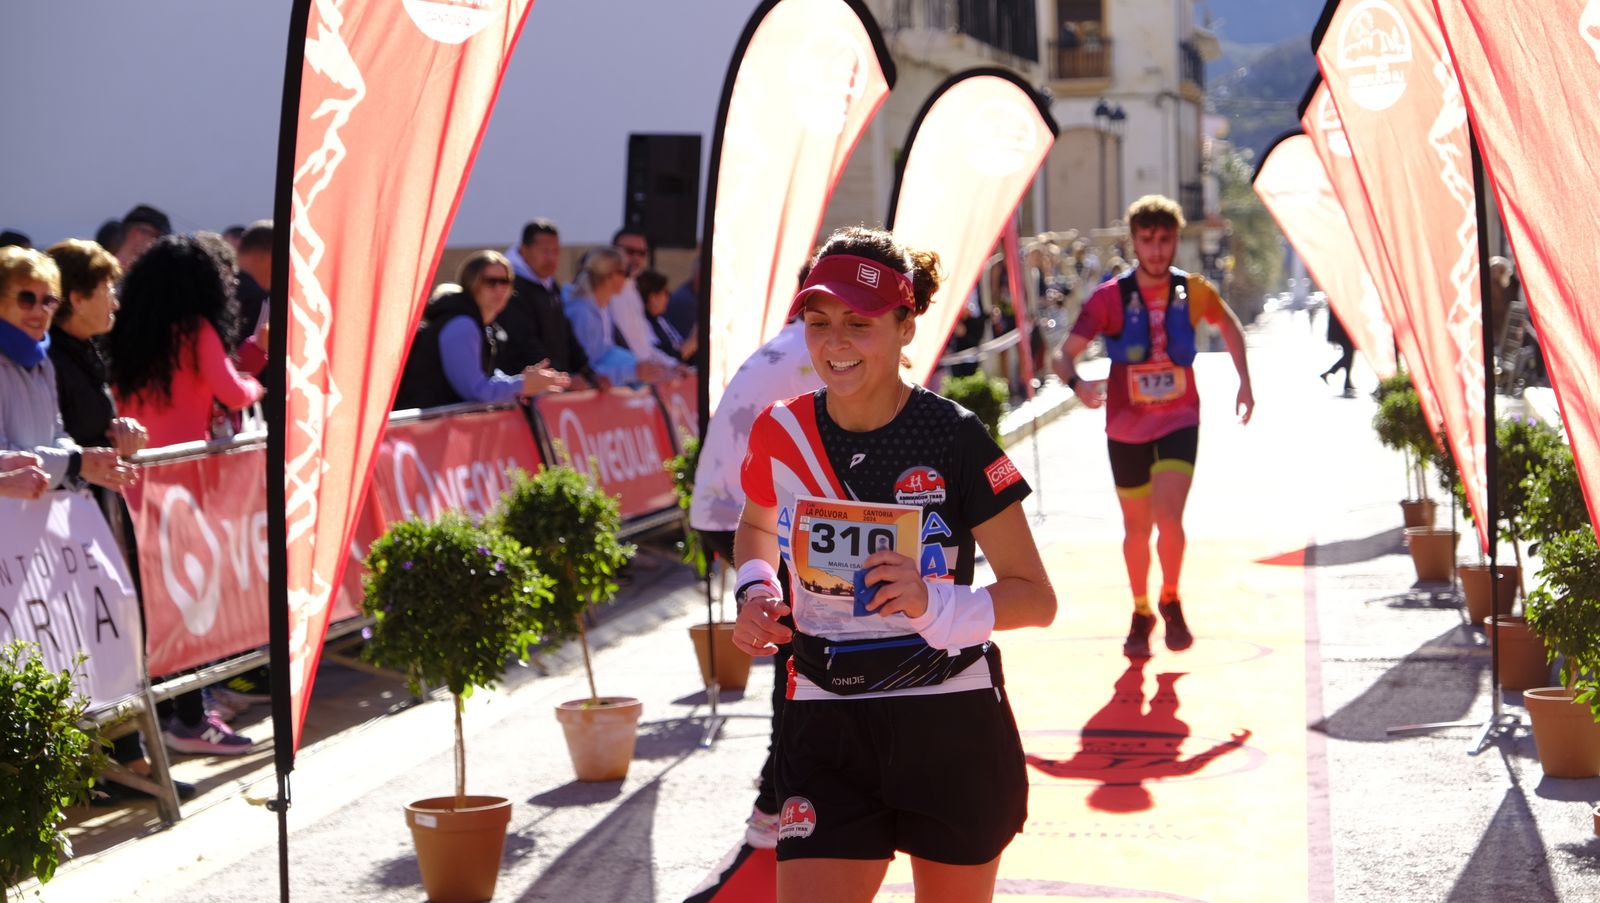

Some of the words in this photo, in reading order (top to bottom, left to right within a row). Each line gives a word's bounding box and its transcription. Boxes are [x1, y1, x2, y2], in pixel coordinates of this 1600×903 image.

[1141, 372, 1174, 388] 173
[805, 508, 814, 516] LA
[863, 509, 894, 518] CANTORIA
[811, 523, 895, 557] 310
[828, 560, 849, 568] MARIA
